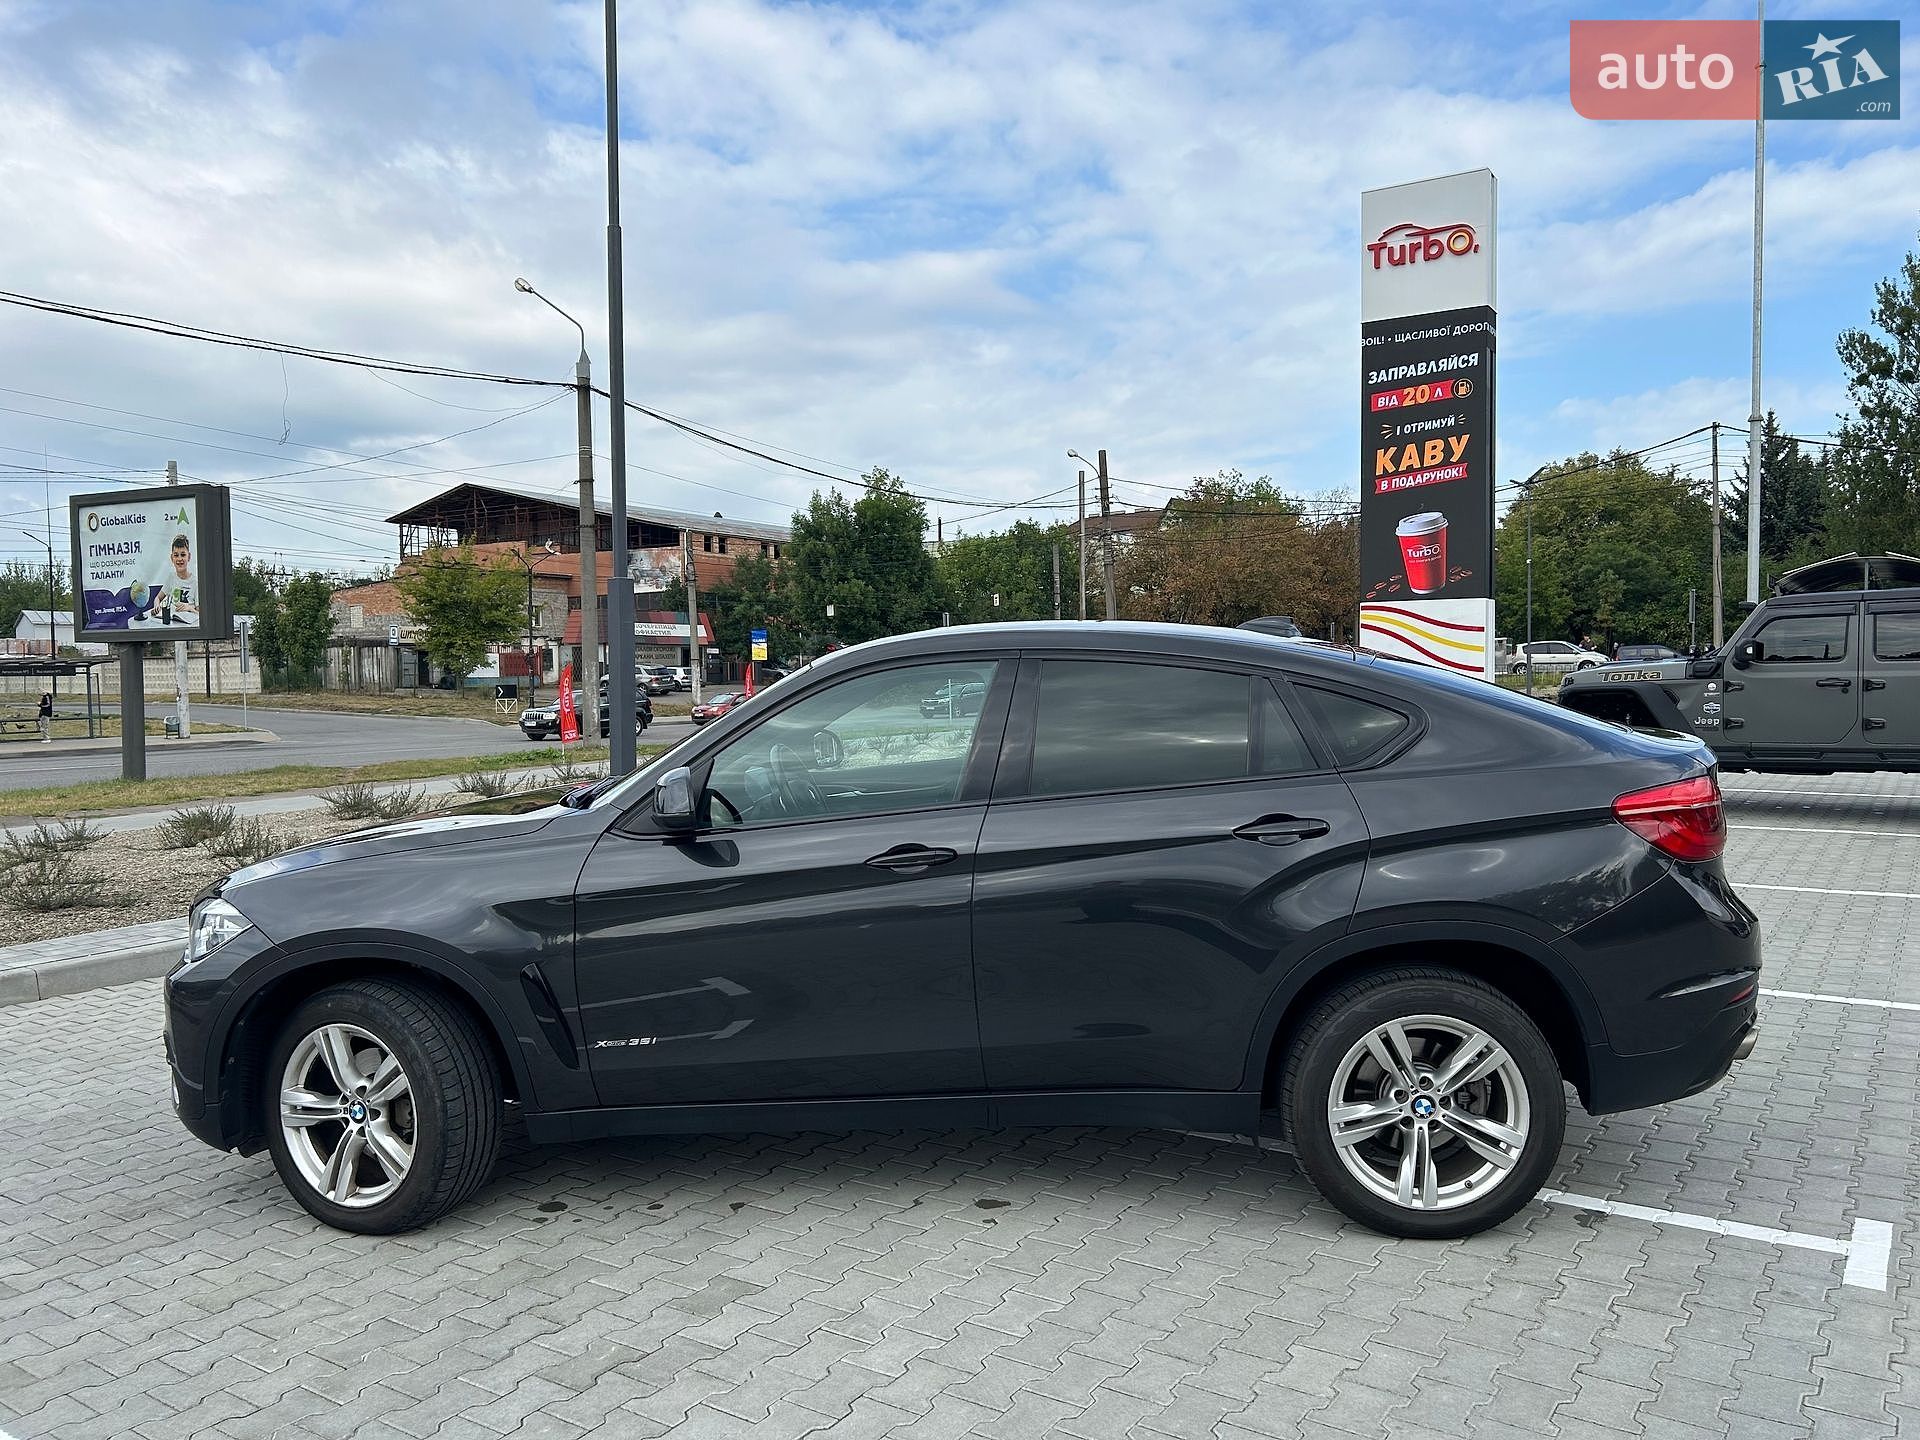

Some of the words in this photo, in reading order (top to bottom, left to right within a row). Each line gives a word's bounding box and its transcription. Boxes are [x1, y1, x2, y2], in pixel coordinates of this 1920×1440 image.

[1395, 326, 1451, 343] ЩАСЛИВОЇ
[1368, 352, 1480, 384] ЗАПРАВЛЯЙСЯ
[1377, 397, 1399, 408] ВІД
[1402, 384, 1430, 407] 20
[1396, 425, 1401, 436] І
[1403, 415, 1456, 434] ОТРИМУЙ
[1375, 434, 1471, 476] КАВУ
[1380, 480, 1388, 491] В
[1391, 467, 1463, 488] ПОДАРУНОК!
[100, 513, 146, 527] GlobalKids
[164, 513, 169, 521] 2
[90, 570, 125, 580] ТАЛАНТИ
[1598, 669, 1663, 683] Tonka
[1694, 716, 1720, 726] Jeep
